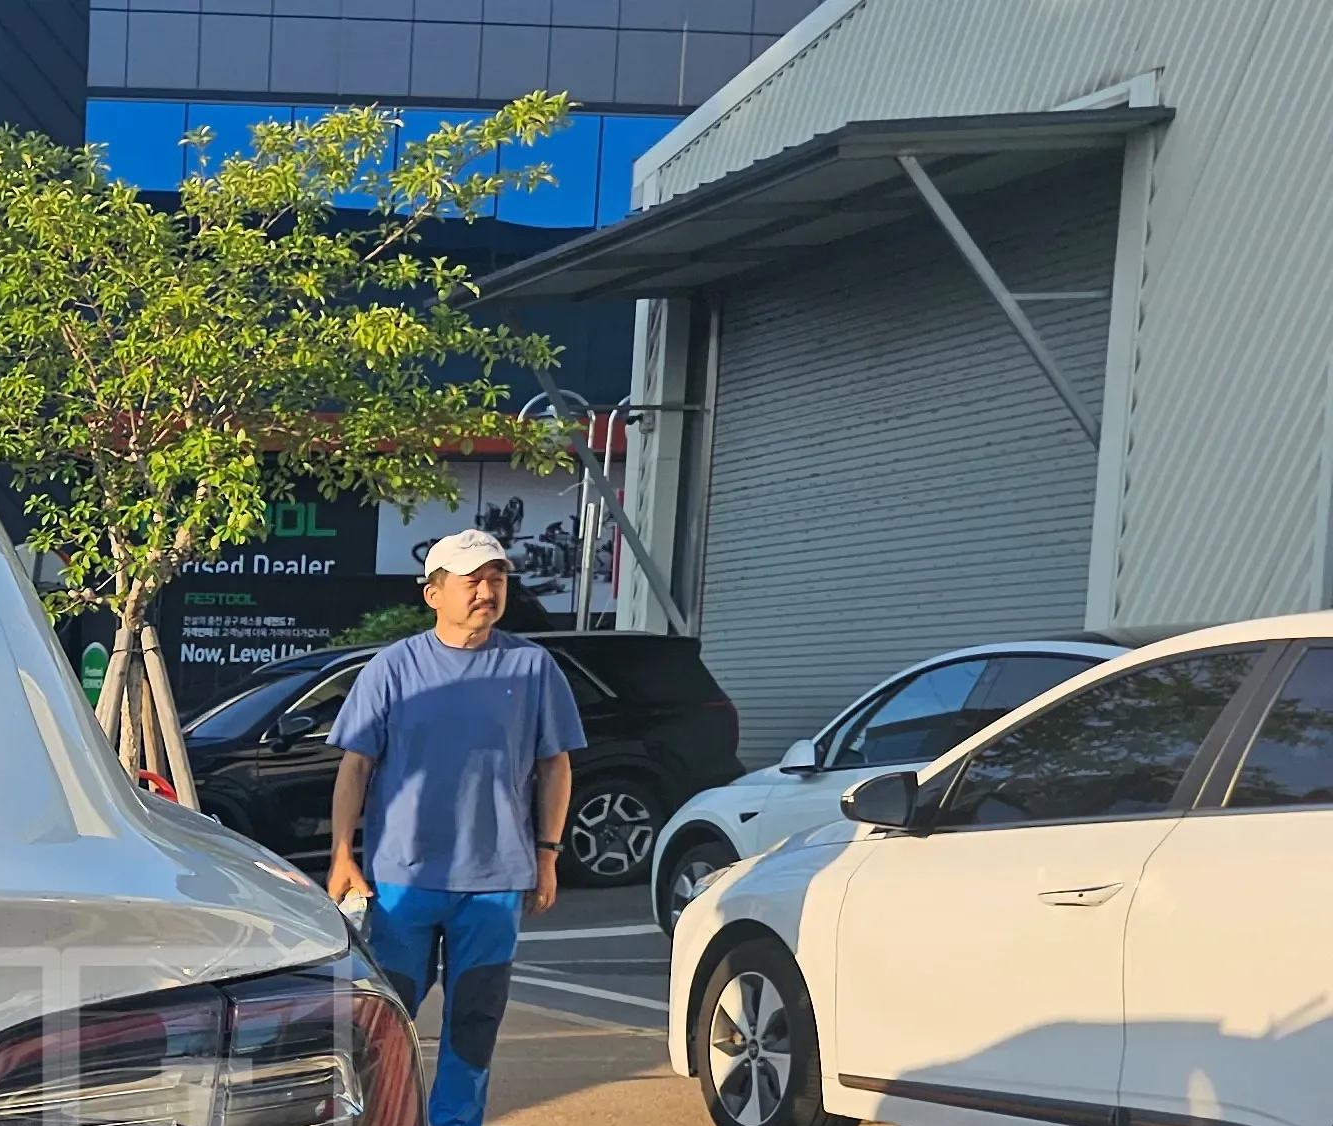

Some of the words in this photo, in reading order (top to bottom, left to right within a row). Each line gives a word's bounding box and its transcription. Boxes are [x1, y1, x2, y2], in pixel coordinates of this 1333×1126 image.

[184, 592, 257, 605] FESTOOL
[180, 643, 225, 666] Now,
[229, 643, 278, 663] Level
